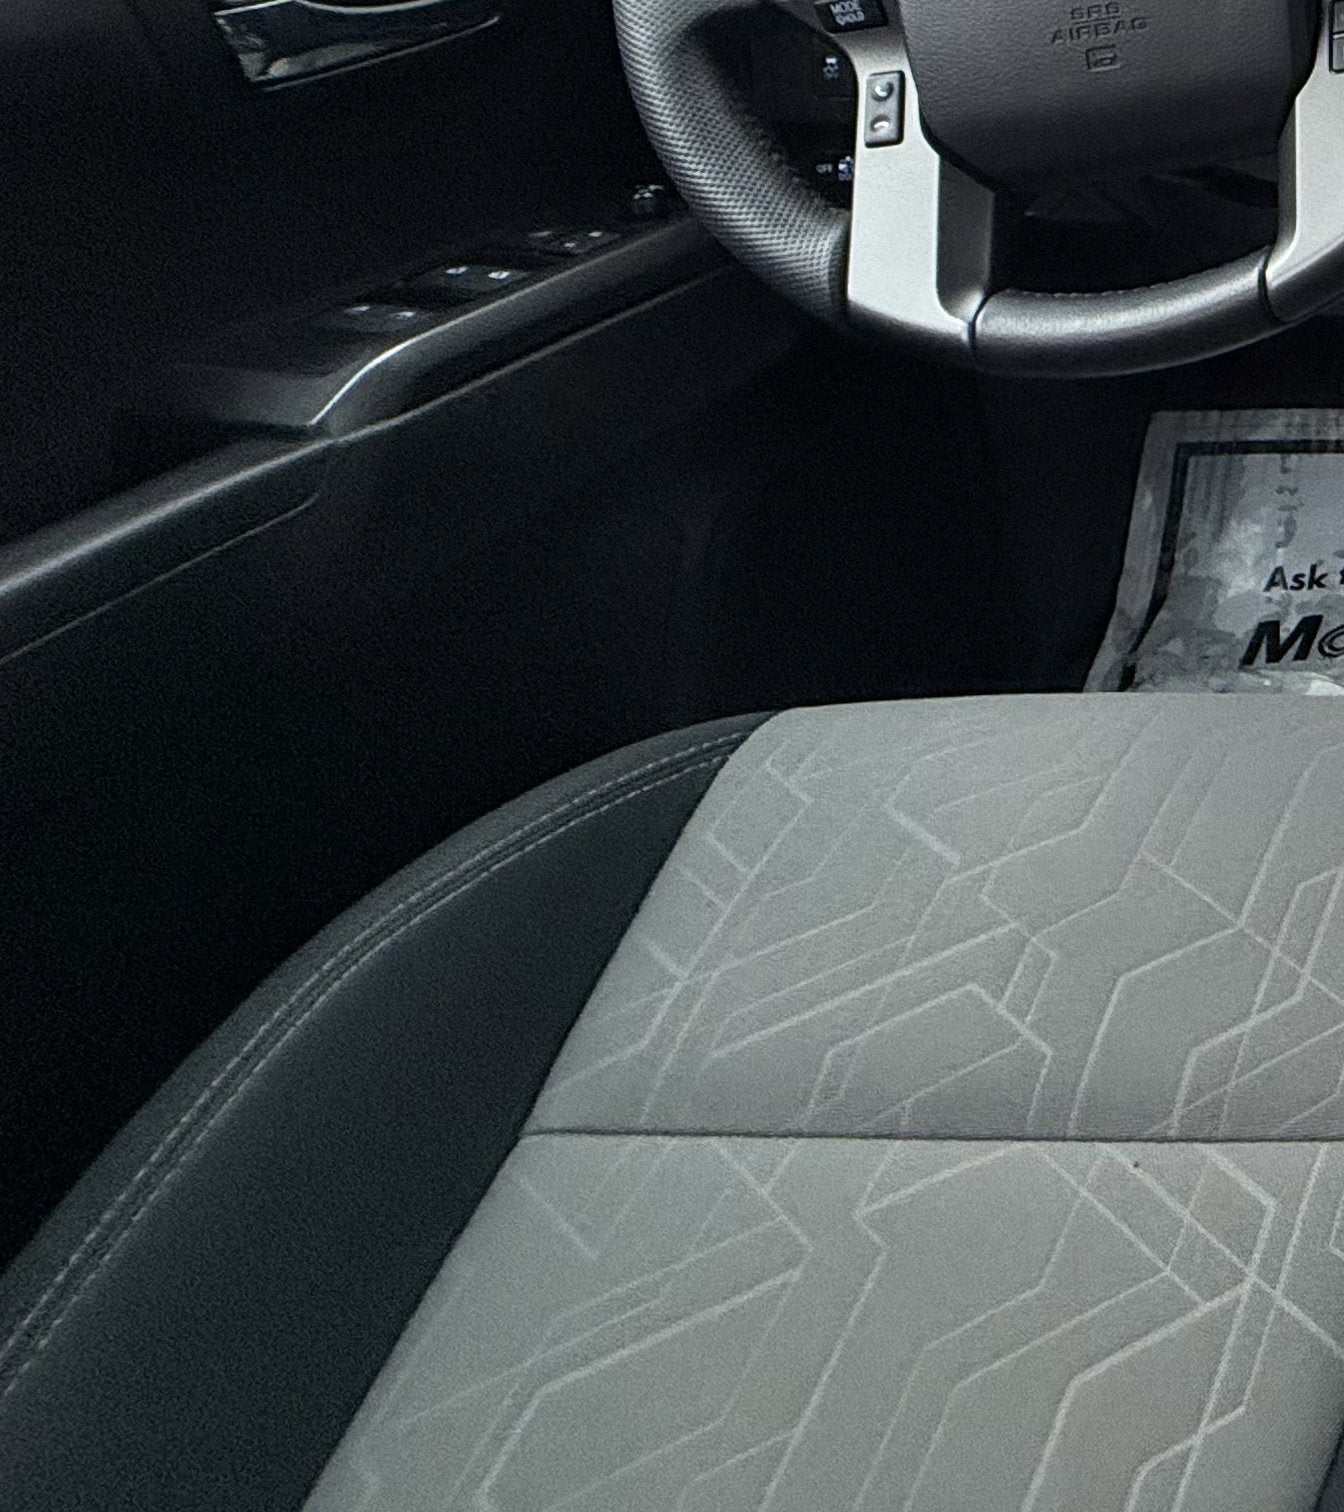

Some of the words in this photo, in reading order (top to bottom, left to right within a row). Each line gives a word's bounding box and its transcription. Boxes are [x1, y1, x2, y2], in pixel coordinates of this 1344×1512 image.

[830, 0, 863, 14] MODE
[1070, 1, 1120, 20] SRS
[1051, 16, 1149, 44] AIRBAG
[1263, 563, 1329, 594] Ask
